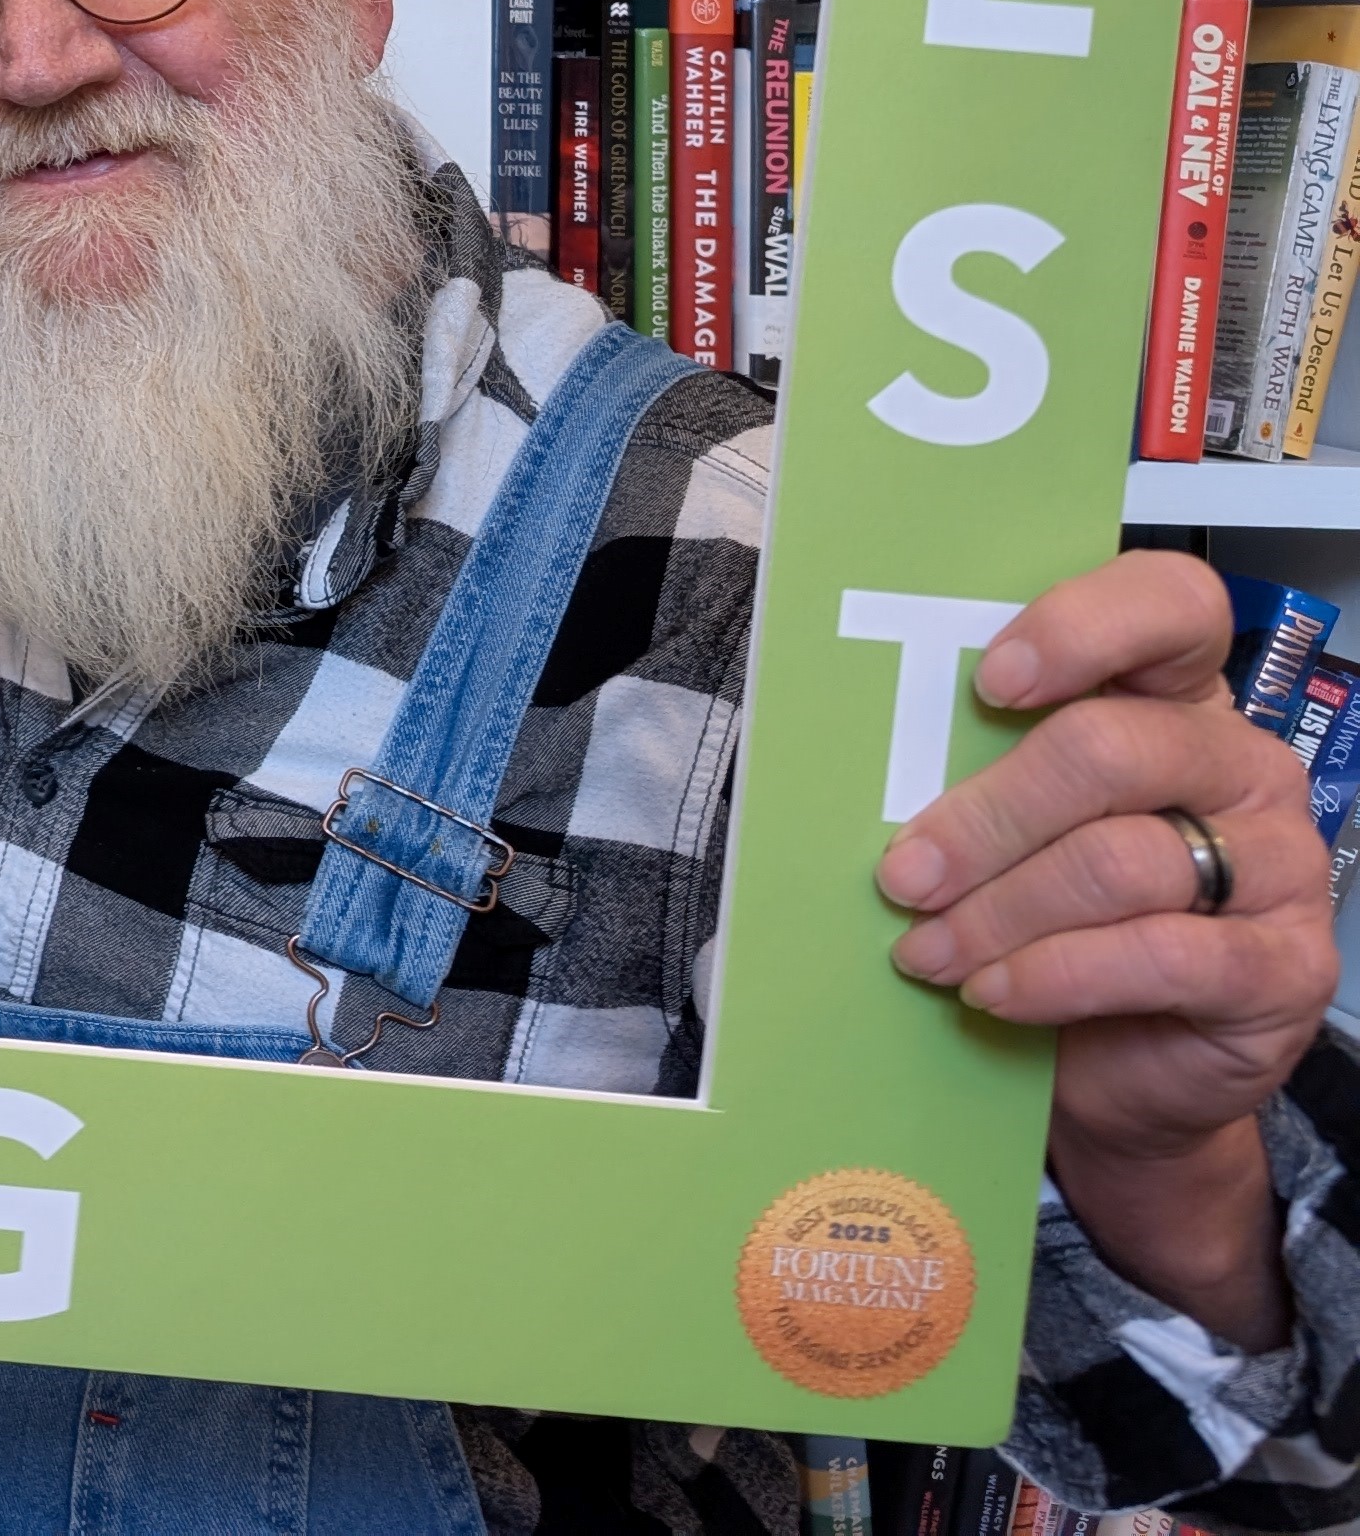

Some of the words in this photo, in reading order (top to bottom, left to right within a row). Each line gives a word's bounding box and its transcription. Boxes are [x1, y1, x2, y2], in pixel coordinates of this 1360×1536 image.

[510, 10, 533, 24] PRINT
[767, 18, 789, 54] THE
[1187, 24, 1223, 111] OPAL
[1226, 40, 1236, 61] The
[498, 88, 542, 100] BEAUTY
[501, 72, 514, 84] IN
[519, 72, 540, 84] THE
[686, 46, 703, 148] WAHRER
[710, 51, 725, 145] CAITLIN
[1221, 66, 1235, 107] FINAL
[1327, 76, 1342, 101] THE
[498, 103, 516, 115] OF
[519, 104, 542, 115] THE
[503, 118, 538, 130] LILIES
[575, 100, 588, 138] FIRE
[765, 60, 790, 195] REUNION
[1188, 113, 1209, 130] &
[504, 150, 536, 162] JOHN
[1218, 111, 1231, 170] REVIVAL
[1305, 104, 1340, 183] LYING
[498, 164, 542, 177] UPDIKE
[573, 143, 588, 223] WEATHER
[1177, 135, 1213, 207] NEV
[1213, 175, 1223, 196] OF
[695, 170, 717, 228] THE
[1292, 179, 1324, 257] GAME
[1327, 248, 1353, 283] Let
[694, 239, 716, 365] DAMAGE
[1177, 277, 1200, 354] DAWNIE
[1279, 275, 1304, 340] RUTH
[1320, 294, 1342, 317] Us
[1265, 344, 1293, 410] WARE
[1296, 323, 1332, 413] Descend
[1171, 356, 1194, 434] WALTON
[828, 1223, 890, 1243] 2025
[771, 1247, 944, 1291] FORTUNE
[781, 1281, 929, 1312] MAGAZINE
